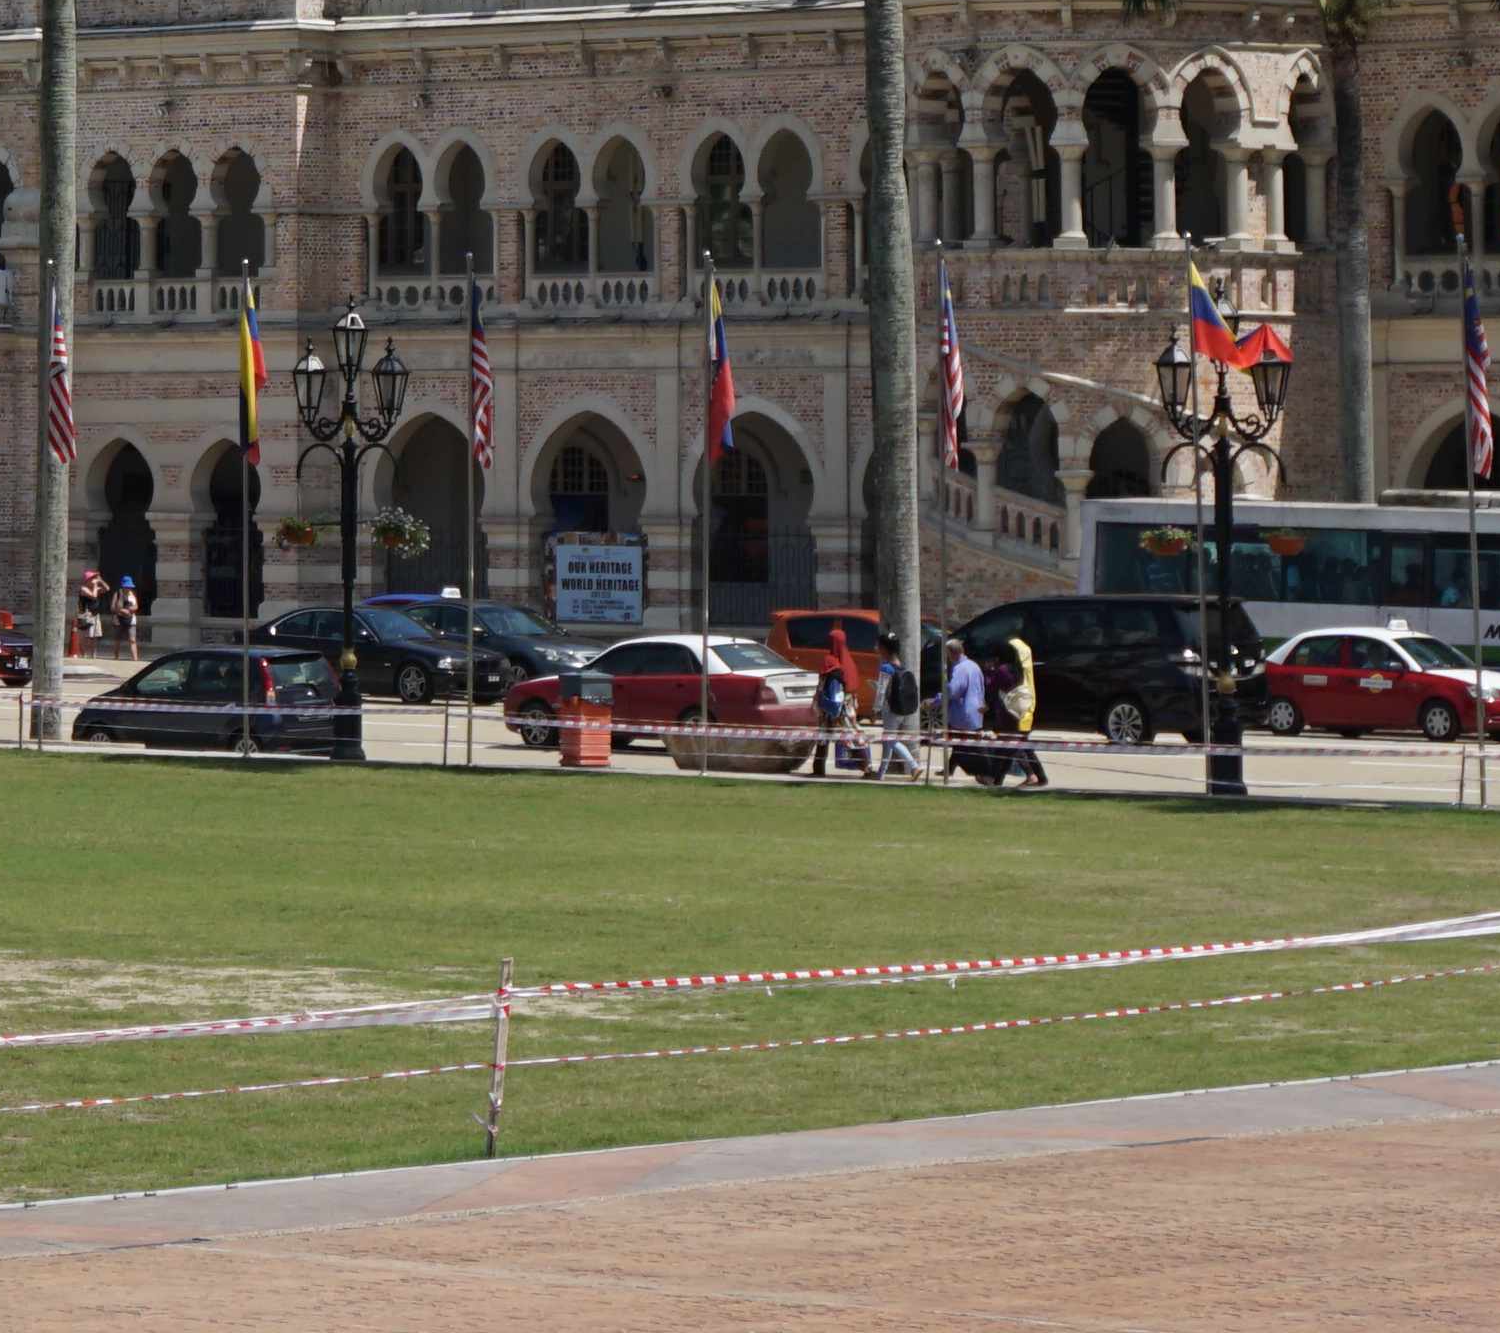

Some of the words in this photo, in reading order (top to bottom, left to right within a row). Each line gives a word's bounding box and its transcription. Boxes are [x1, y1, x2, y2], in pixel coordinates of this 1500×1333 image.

[568, 561, 586, 574] OUR
[589, 562, 632, 574] HERITAGE
[561, 578, 593, 590] WORLD
[596, 579, 639, 591] HERITAGE
